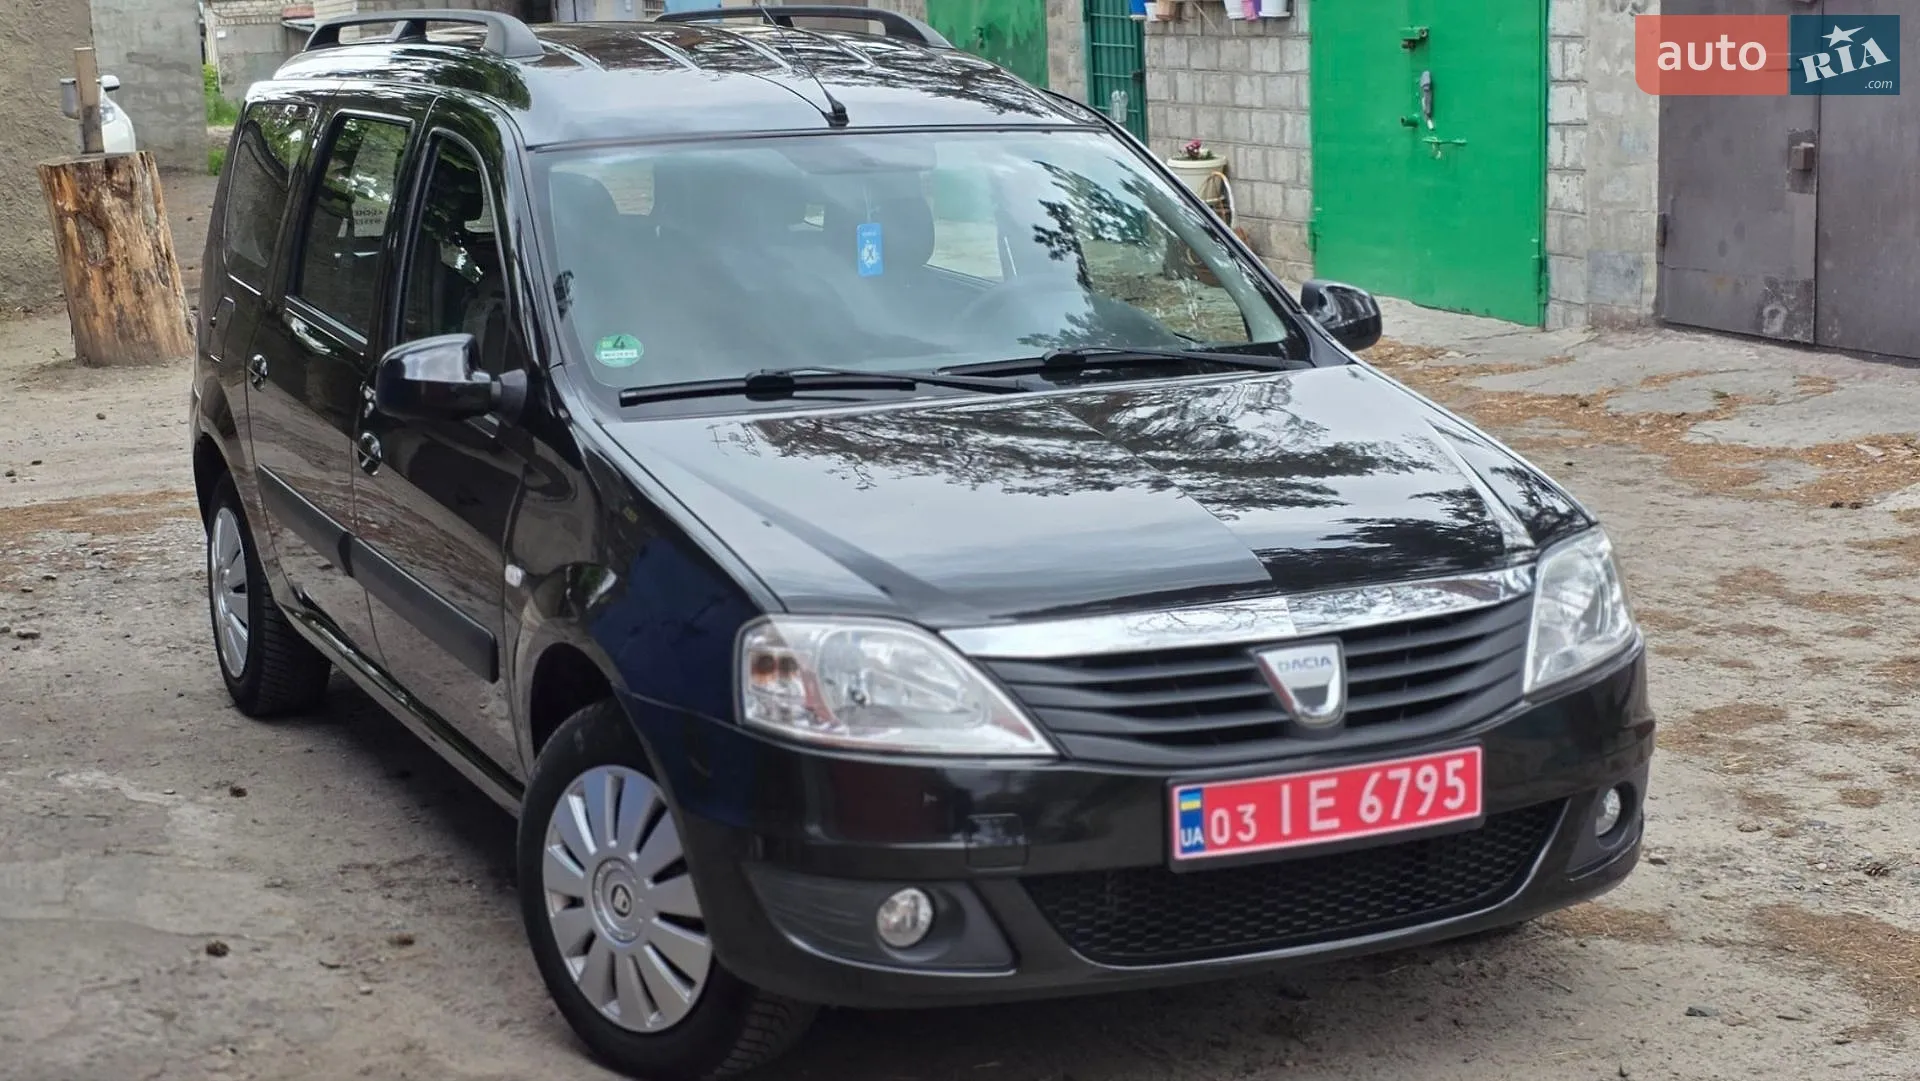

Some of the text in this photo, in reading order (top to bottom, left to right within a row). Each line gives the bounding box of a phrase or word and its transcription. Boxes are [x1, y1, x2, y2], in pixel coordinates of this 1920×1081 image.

[612, 335, 627, 350] 4
[1277, 655, 1332, 672] DACIA
[1210, 758, 1467, 846] 03 IE 6795
[1180, 827, 1205, 847] UA
